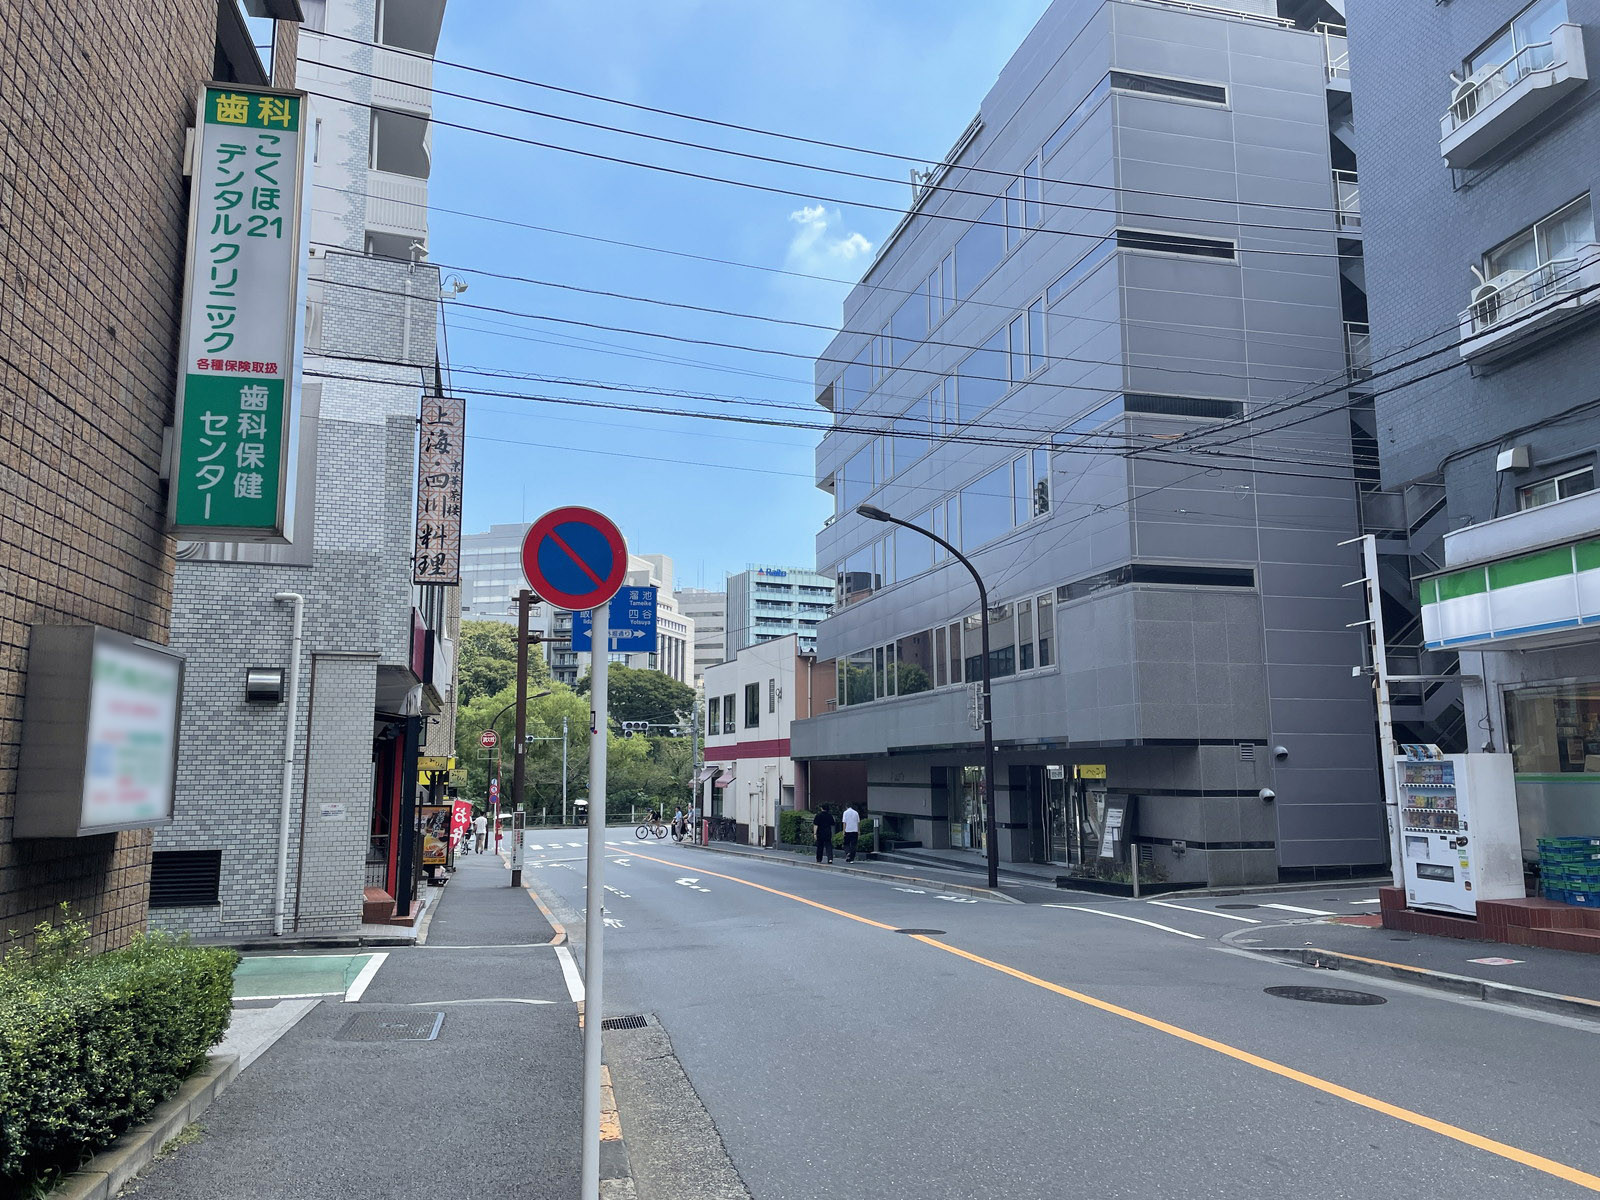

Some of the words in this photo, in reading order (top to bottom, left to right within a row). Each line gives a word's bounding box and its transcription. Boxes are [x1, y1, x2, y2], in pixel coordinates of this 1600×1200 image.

[215, 93, 292, 128] 歯科
[247, 133, 283, 239] こくほ21
[203, 142, 247, 354] デンタルクリニック
[196, 358, 278, 375] 各種保険取扱
[195, 410, 229, 520] センター
[233, 384, 270, 499] 歯科保健
[418, 405, 454, 576] 上海・四川料理
[628, 609, 653, 619] 四谷
[629, 590, 653, 600] 溜池
